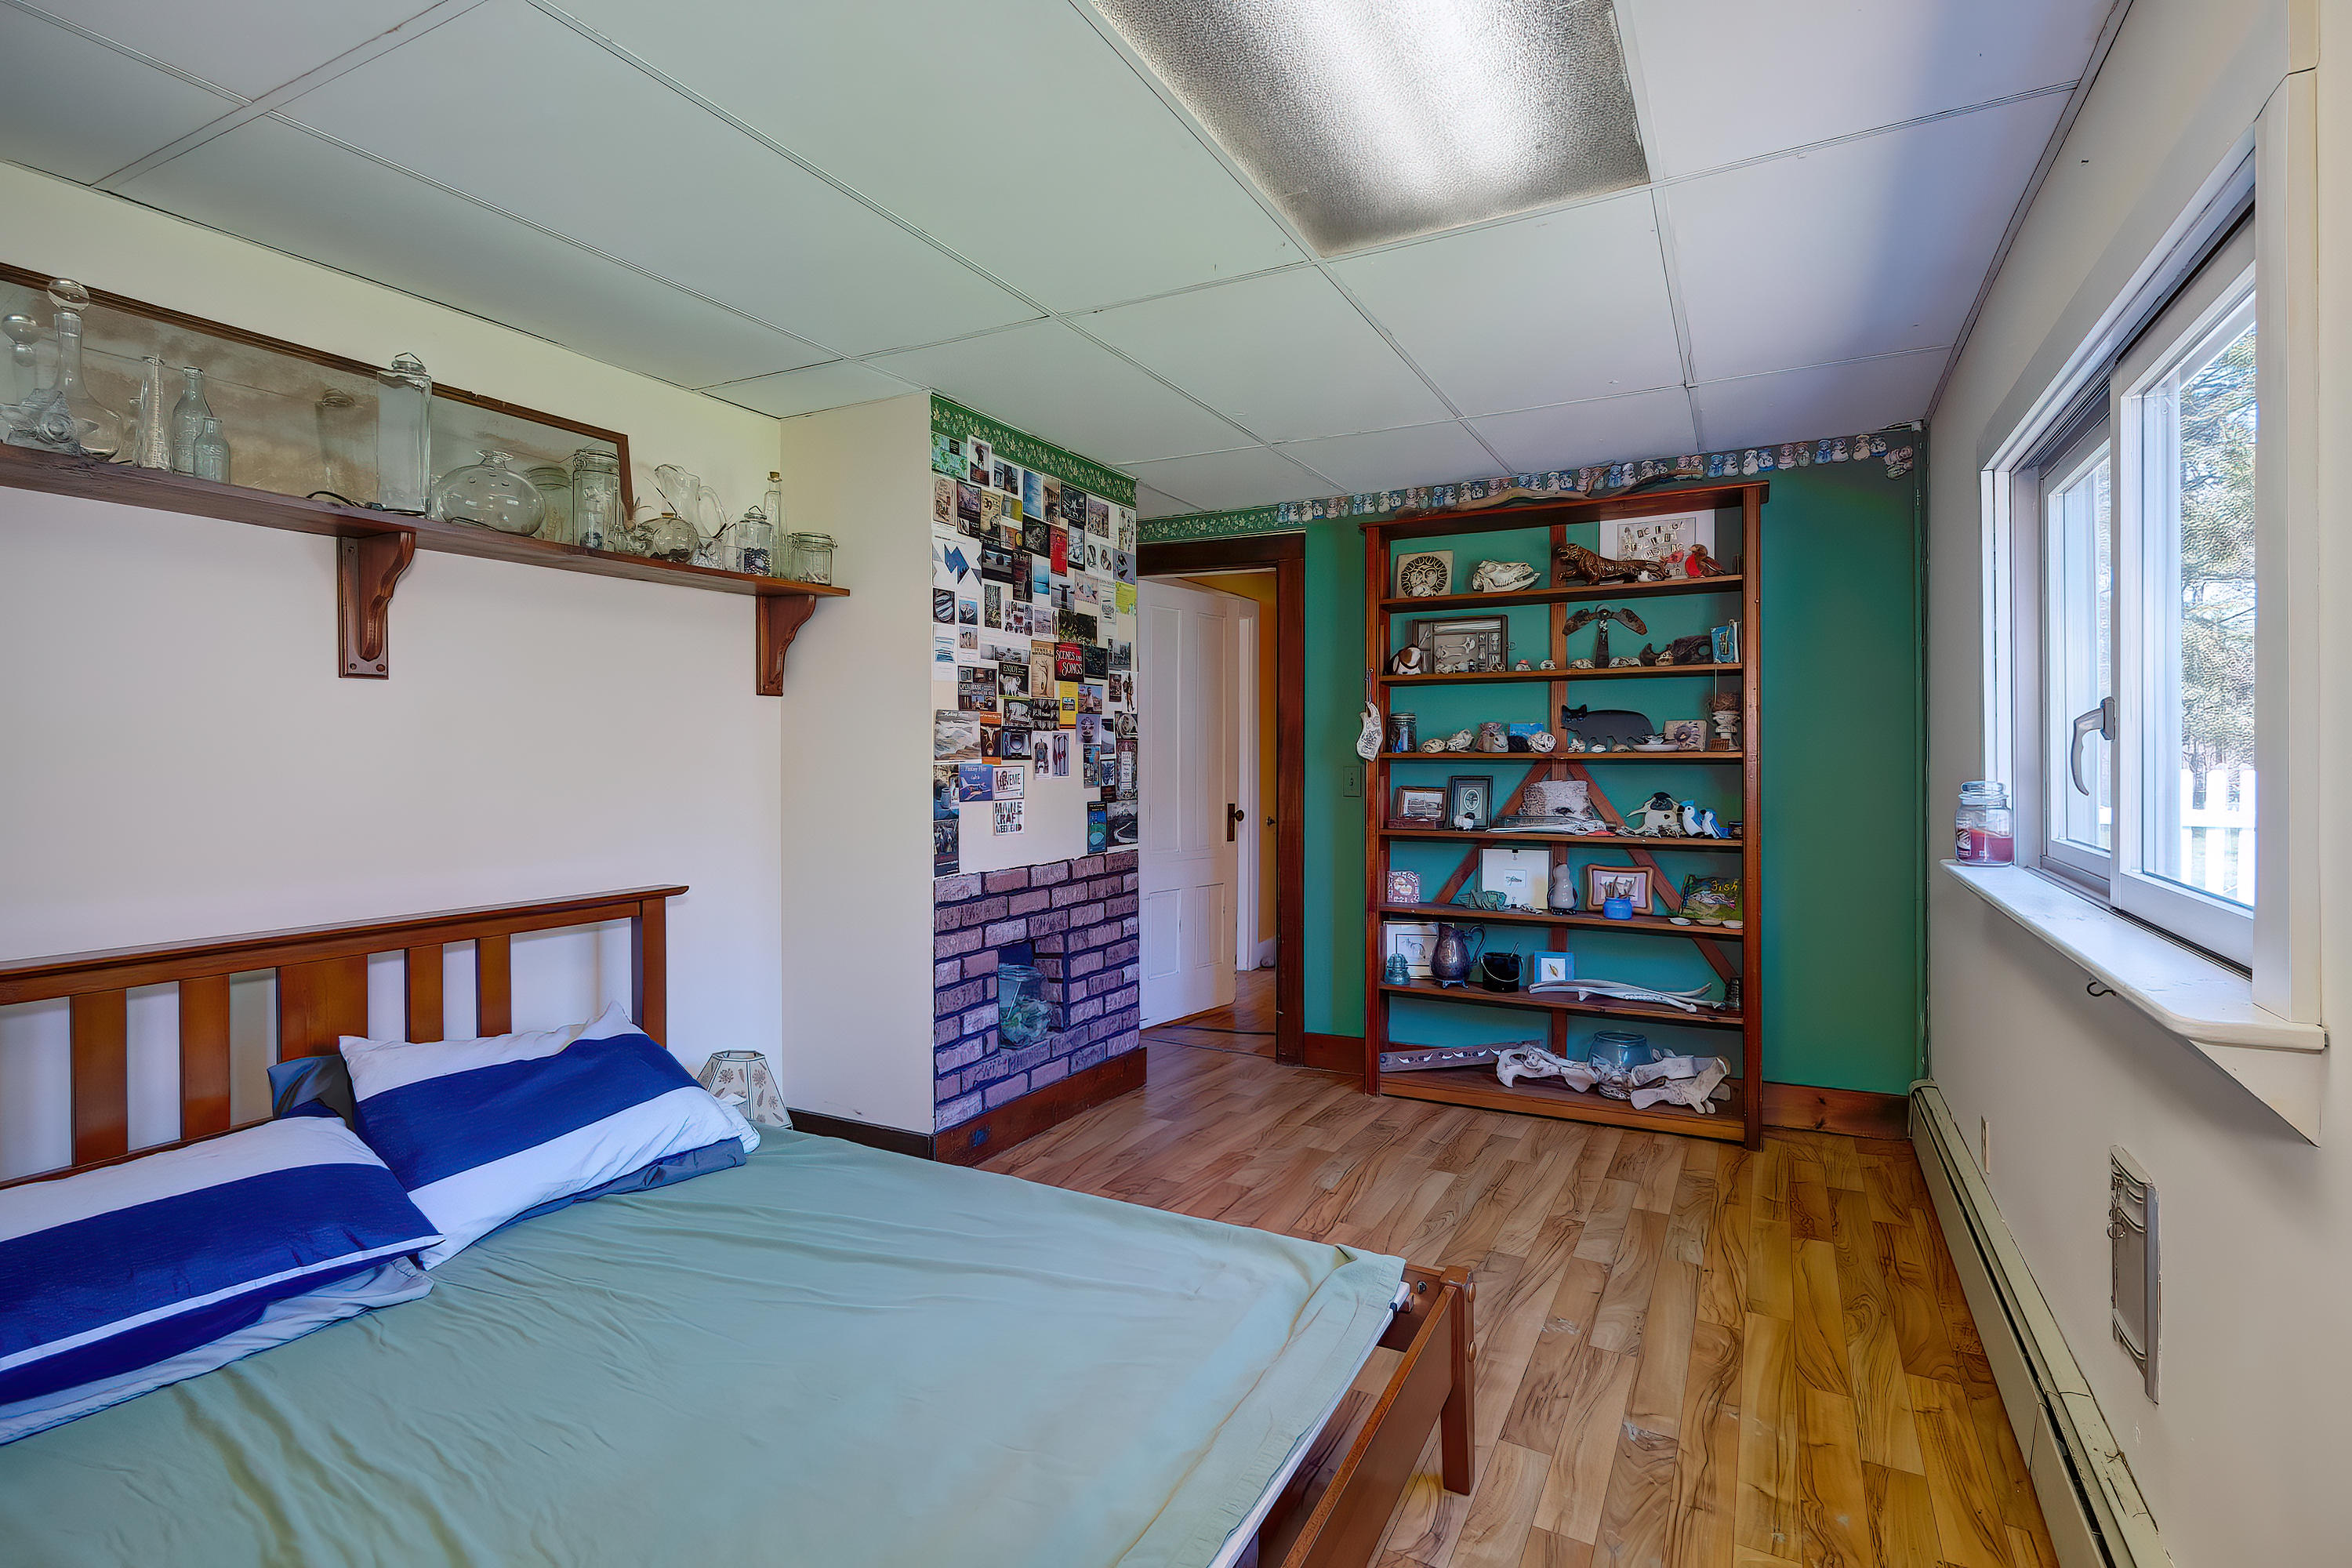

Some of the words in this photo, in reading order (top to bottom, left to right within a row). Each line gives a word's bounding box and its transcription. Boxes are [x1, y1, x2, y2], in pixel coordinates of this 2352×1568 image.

[1055, 649, 1076, 662] SCENES
[1062, 662, 1083, 676] SONGS
[995, 802, 1022, 814] MAINE
[995, 812, 1022, 825] CRAFT
[996, 824, 1022, 833] WEEKEND
[1711, 880, 1738, 891] Fish
